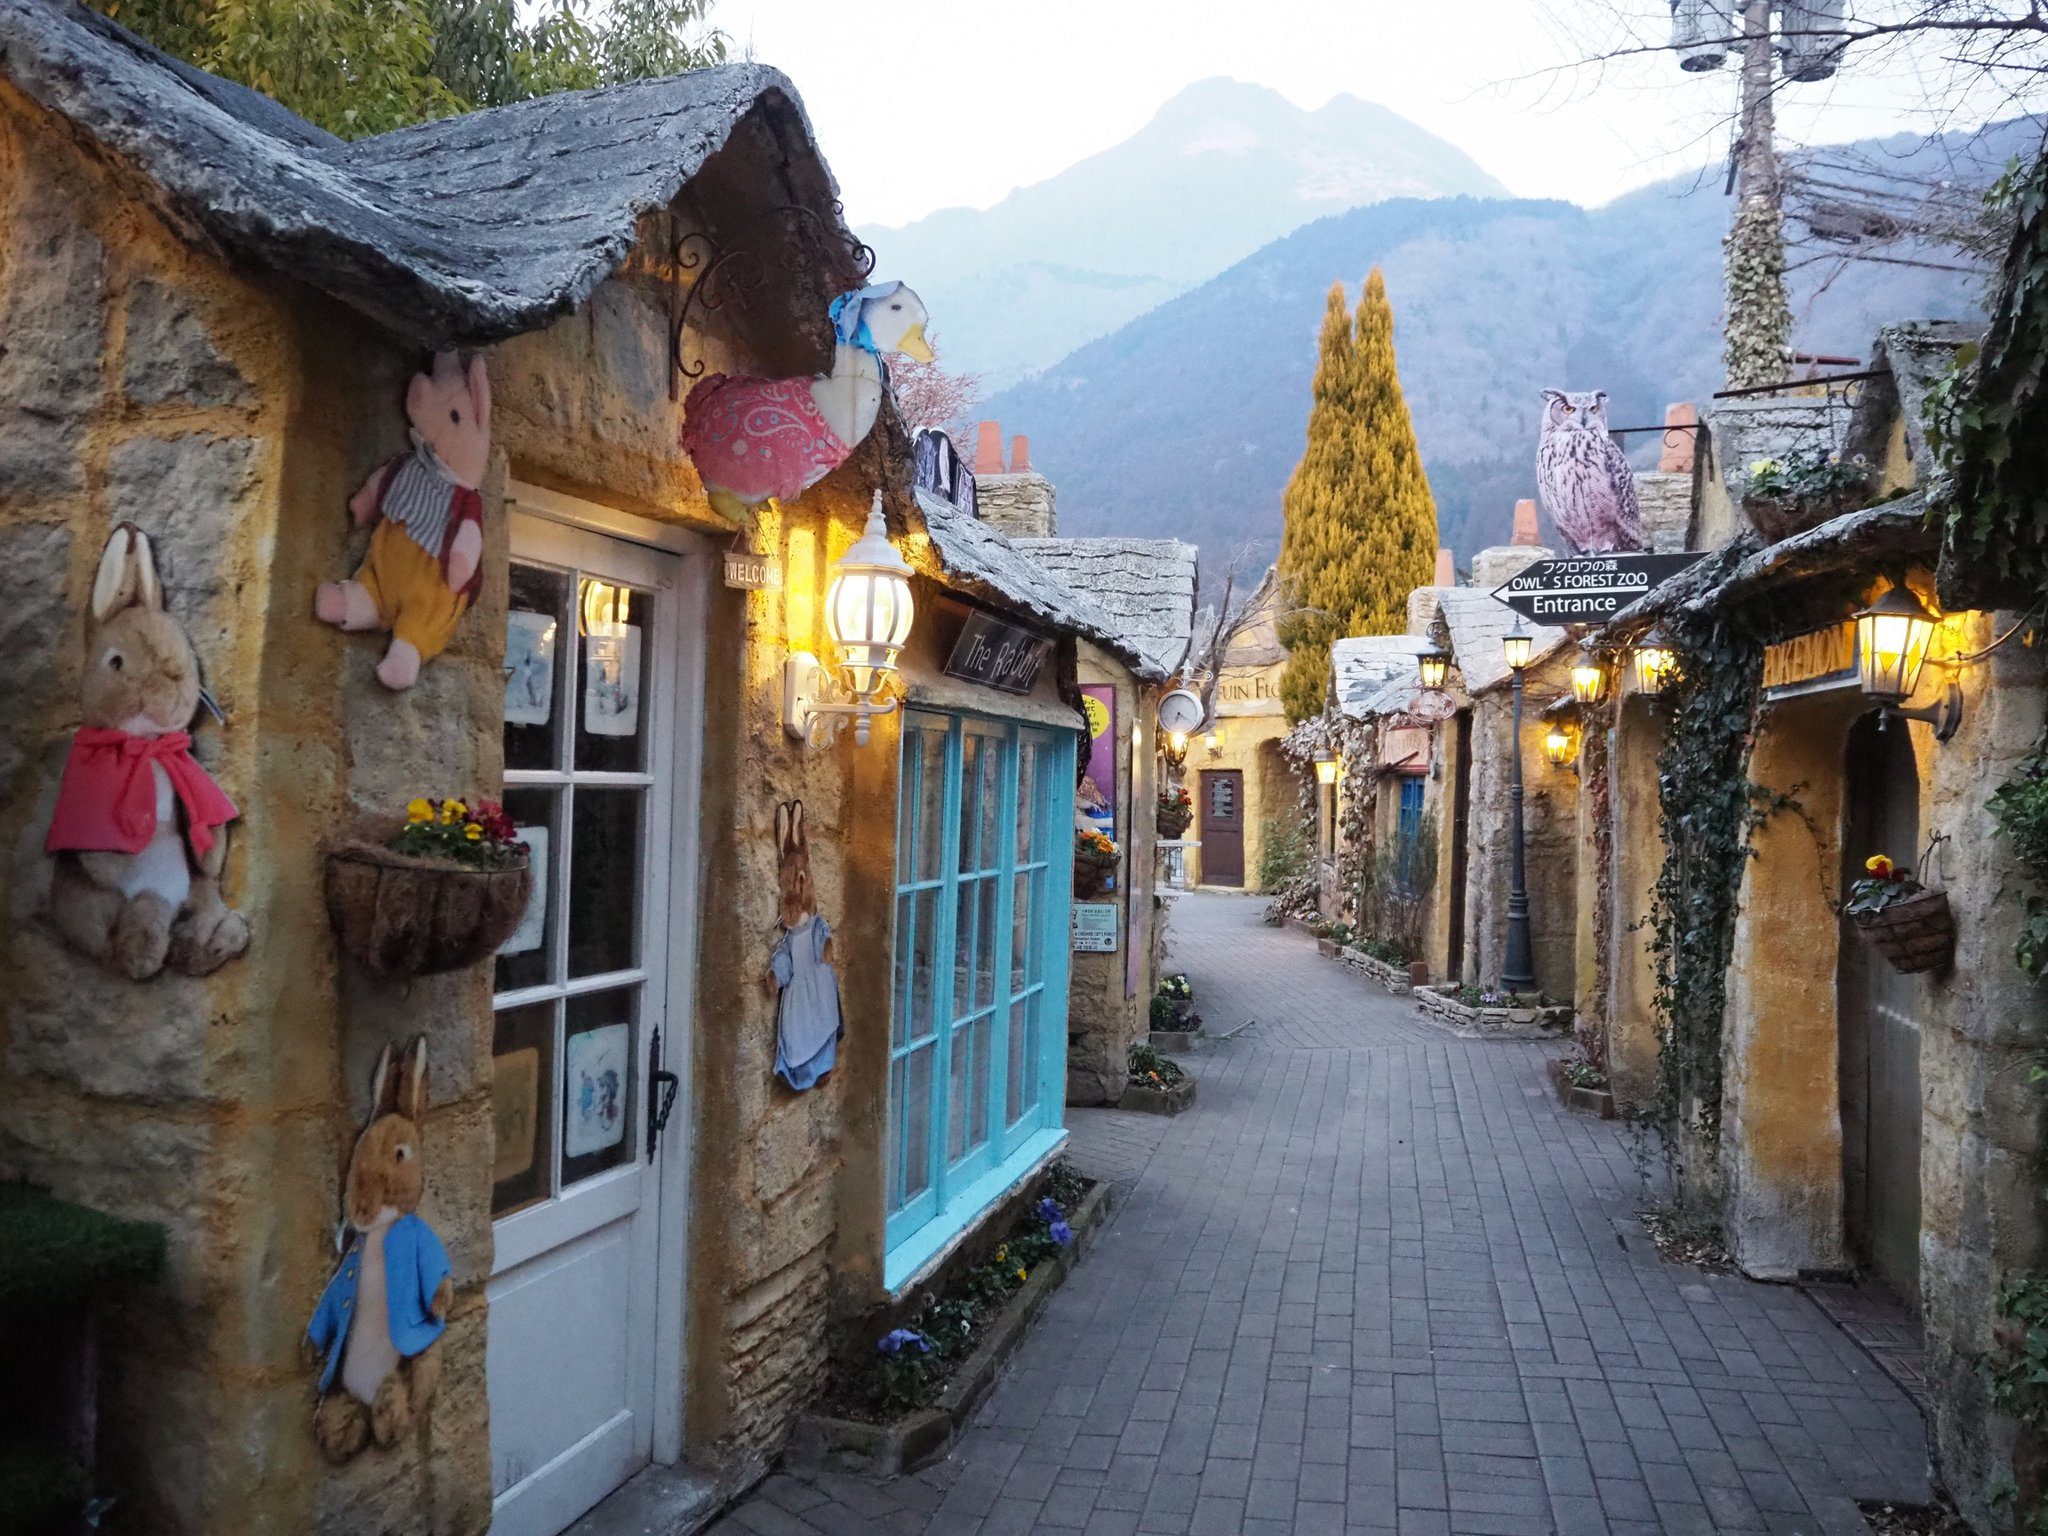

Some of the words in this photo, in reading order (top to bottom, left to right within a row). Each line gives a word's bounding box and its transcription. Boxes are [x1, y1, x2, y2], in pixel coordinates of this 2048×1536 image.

[729, 562, 783, 585] WELCOME
[1542, 559, 1618, 574] フクロウの森
[1565, 573, 1614, 588] FOREST
[1617, 572, 1648, 586] ZOO
[1533, 596, 1617, 614] Entrance
[964, 633, 991, 671] The
[990, 639, 1041, 688] Rabbit
